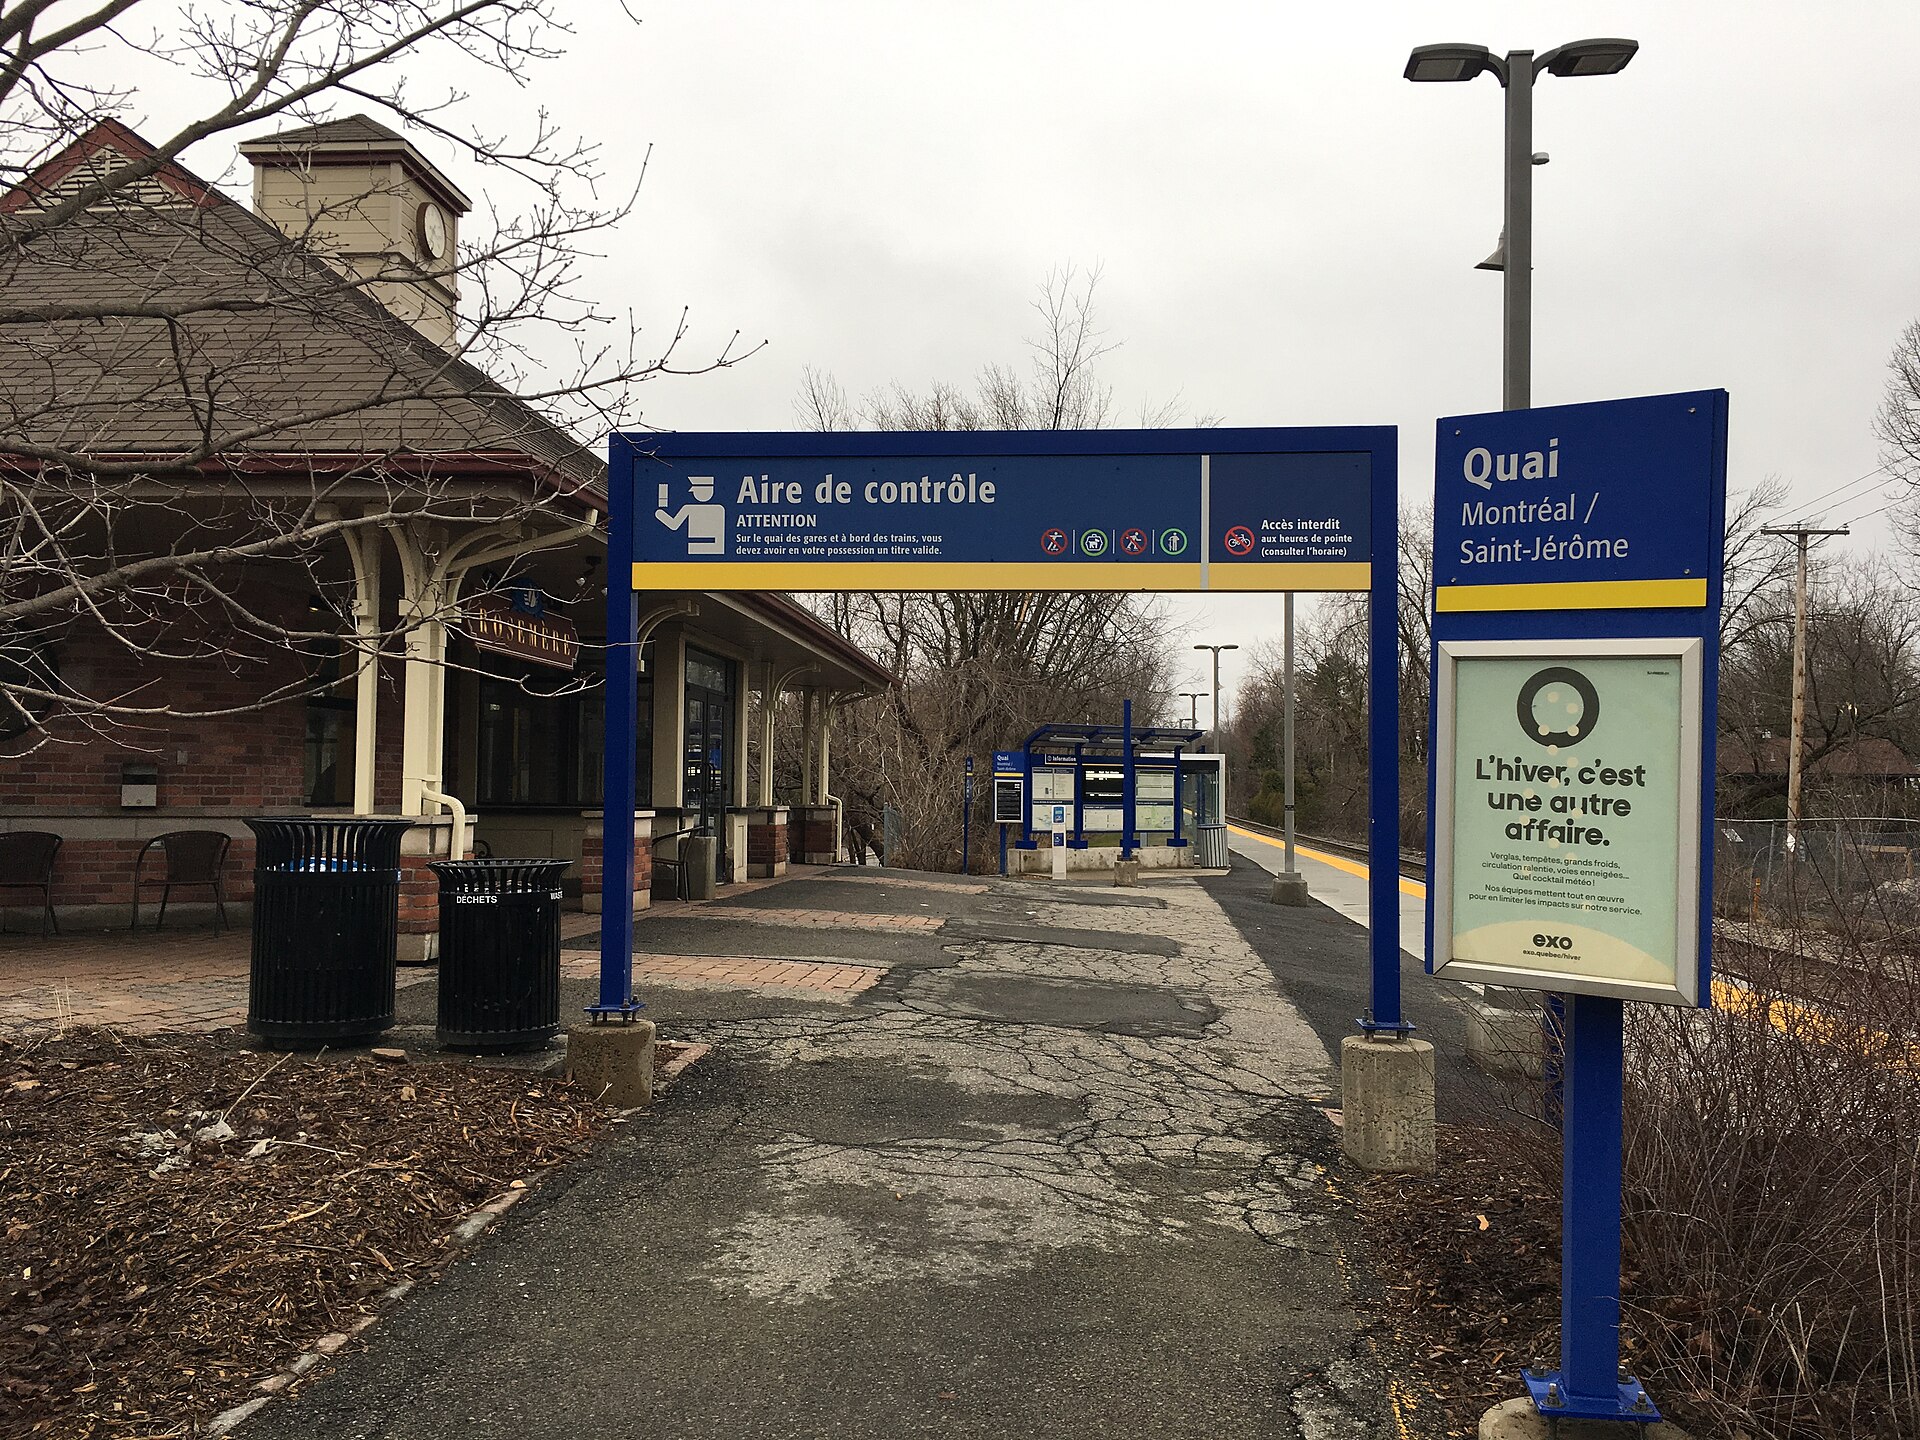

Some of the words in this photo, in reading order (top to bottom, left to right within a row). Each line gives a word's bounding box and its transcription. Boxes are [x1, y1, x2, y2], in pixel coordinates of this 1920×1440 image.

[1463, 438, 1558, 490] Quai
[736, 474, 802, 504] Aire
[815, 473, 851, 504] de
[865, 473, 996, 504] contrôle
[1462, 494, 1575, 526] Montréal
[1583, 492, 1600, 524] /
[736, 514, 816, 528] ATTENTION
[1261, 518, 1293, 530] Accès
[1297, 518, 1340, 530] interdit
[736, 533, 751, 543] Sur
[753, 533, 762, 543] le
[764, 533, 783, 546] quai
[785, 533, 800, 543] des
[803, 535, 827, 546] gares
[829, 534, 839, 543] et
[841, 533, 847, 543] à
[849, 533, 870, 543] bord
[872, 533, 887, 543] des
[890, 533, 919, 545] trains,
[921, 535, 942, 543] vous
[1279, 533, 1308, 543] heures
[1310, 533, 1322, 543] de
[1324, 533, 1352, 545] pointe
[736, 545, 761, 554] devez
[763, 545, 786, 554] avoir
[801, 546, 824, 554] votre
[827, 545, 874, 557] possession
[890, 545, 909, 554] titre
[911, 545, 942, 554] valide.
[1261, 546, 1304, 558] (consulter
[1306, 546, 1346, 558] l'horaire)
[1461, 533, 1629, 564] Saint-Jérôme
[478, 608, 571, 656] ROSEMÈRE
[1476, 755, 1571, 786] L'hiver,
[1577, 758, 1647, 788] c'est
[1487, 791, 1542, 812] une
[1549, 793, 1631, 816] autre
[1504, 819, 1610, 846] affaire.
[1482, 861, 1523, 871] circulation
[1523, 864, 1556, 874] ralentie,
[1557, 867, 1578, 876] voies
[1490, 852, 1521, 862] Verglas,
[1522, 854, 1562, 865] tempêtes,
[1564, 857, 1593, 867] grands
[1594, 859, 1620, 869] froids,
[1512, 872, 1532, 881] Quel
[1533, 875, 1564, 884] cocktail
[1484, 884, 1501, 893] Nos
[1501, 886, 1533, 896] équipes
[1534, 889, 1566, 898] mettent
[1567, 891, 1584, 899] tout
[1597, 895, 1625, 904] œuvre
[1468, 893, 1487, 901] pour
[1499, 895, 1524, 904] limiter
[1524, 897, 1537, 905] les
[1537, 899, 1570, 909] impacts
[1585, 904, 1607, 912] notre
[1609, 906, 1643, 916] service.
[1532, 933, 1573, 951] exo
[1522, 949, 1582, 961] exo.quebec/hiver
